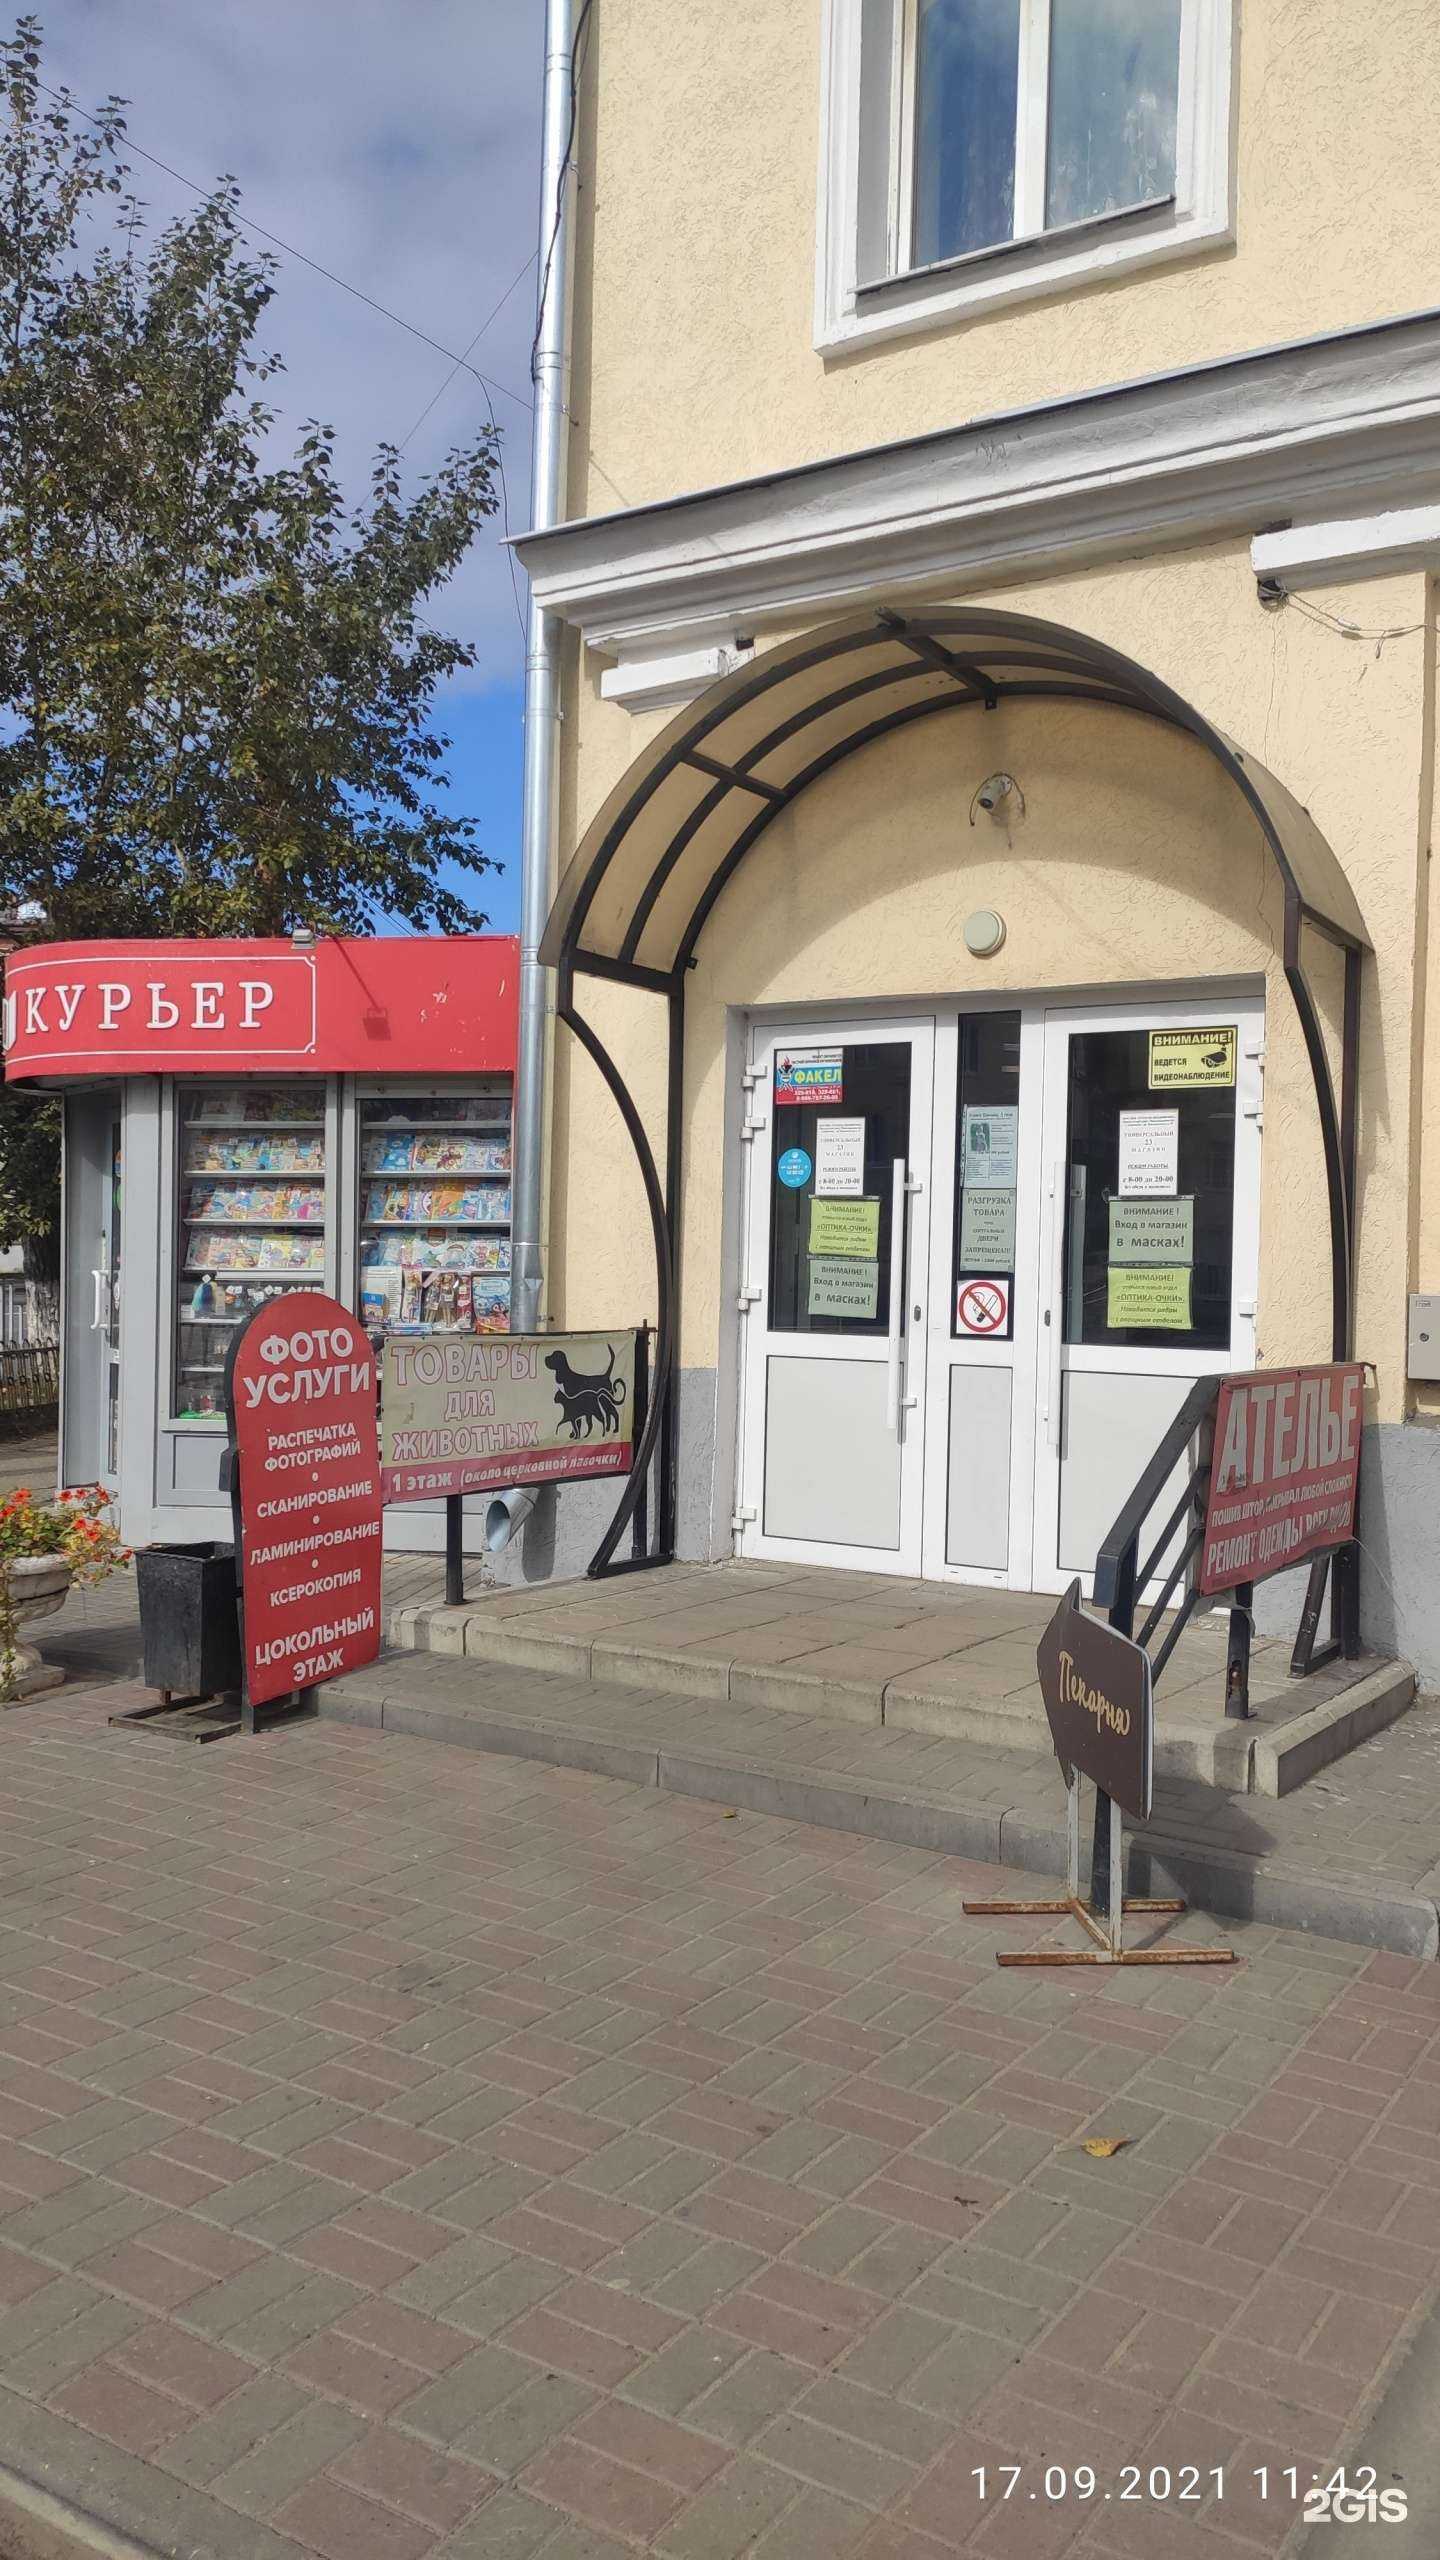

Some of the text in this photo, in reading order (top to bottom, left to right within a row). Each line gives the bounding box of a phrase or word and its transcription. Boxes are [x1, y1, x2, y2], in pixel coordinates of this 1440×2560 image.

[25, 981, 274, 1034] КУРЬЕР
[1154, 1031, 1232, 1046] ВНИМАНИЕ!
[795, 1068, 842, 1084] ФАКЕЛ
[1154, 1058, 1187, 1067] ВЕДЕТСЯ
[1154, 1071, 1230, 1082] ВИДЕОНАБЛЮДЕНИЕ
[1115, 1220, 1138, 1230] Вход
[1148, 1222, 1188, 1230] магазин
[1117, 1236, 1185, 1248] в масках!
[814, 1277, 833, 1287] Вход
[841, 1281, 874, 1289] магазин
[1126, 1274, 1174, 1282] ВНИМАНИЕ!
[815, 1293, 871, 1306] в масках!
[259, 1327, 353, 1365] ФОТО
[391, 1343, 540, 1386] ТОВАРЫ
[242, 1362, 370, 1408] УСЛУГИ
[444, 1389, 496, 1422] ДЛЯ
[268, 1422, 356, 1451] РАСПЕЧАТКА
[392, 1421, 540, 1461] ЖИВОТНЫХ
[1215, 1375, 1360, 1494] АТЕЛЬЕ
[264, 1438, 361, 1472] ФОТОГРАФИЙ
[392, 1475, 402, 1492] 1
[406, 1472, 452, 1491] этаж
[460, 1467, 501, 1487] (около
[257, 1481, 373, 1518] СКАНИРОВАНИЕ
[1211, 1504, 1241, 1527] ПОШИВ
[1301, 1478, 1325, 1501] ЛЮБОЙ
[250, 1521, 380, 1566] ЛАМИНИРОВАНИЕ
[1207, 1531, 1257, 1577] РЕМОНТ
[1258, 1516, 1303, 1564] ОДЕЖДЫ
[270, 1568, 361, 1608] КСЕРОКОПИЯ
[255, 1606, 374, 1665] ЦОКОЛЬНЫЙ
[293, 1647, 344, 1682] ЭТАЖ
[1059, 1651, 1131, 1736] Пекарня
